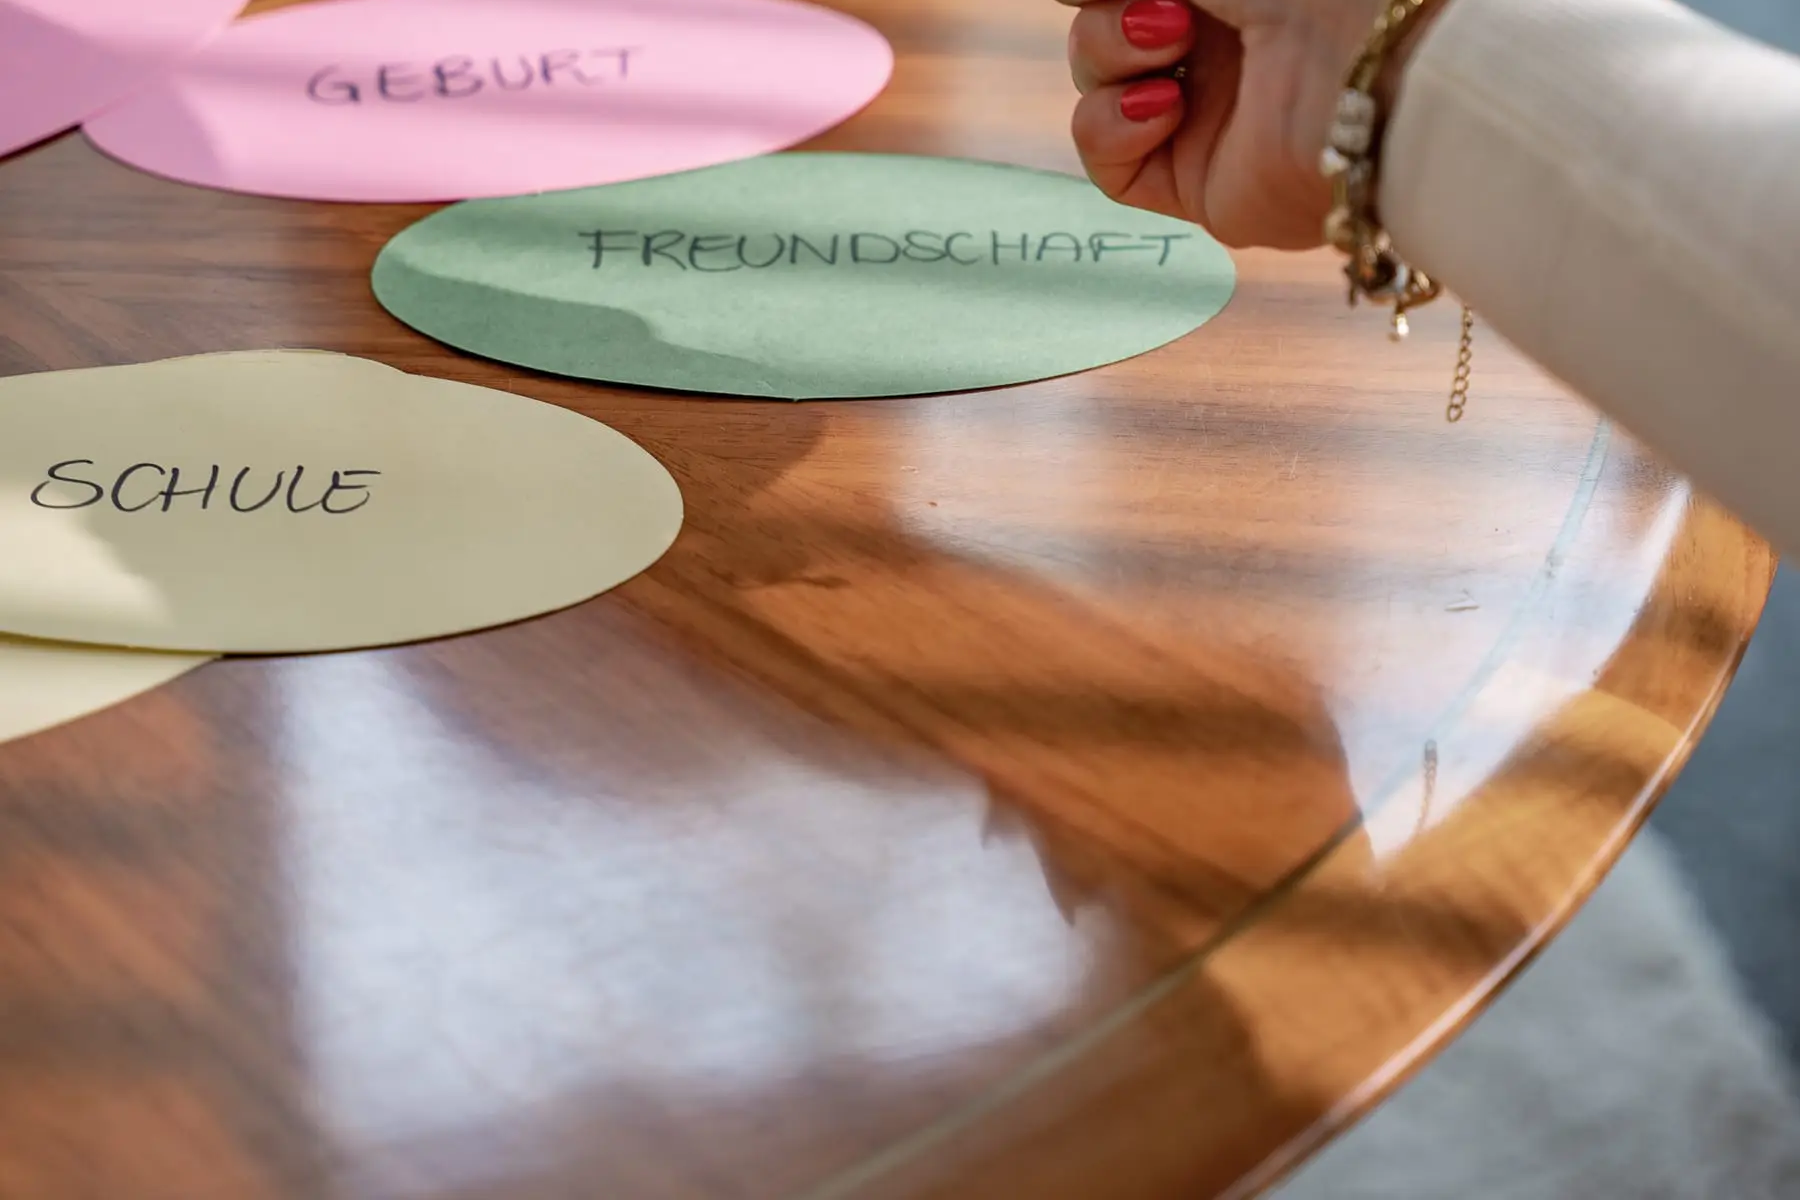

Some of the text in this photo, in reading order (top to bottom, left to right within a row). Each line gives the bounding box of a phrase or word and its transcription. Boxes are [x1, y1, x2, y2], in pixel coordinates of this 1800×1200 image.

[307, 46, 642, 106] GEBURT
[578, 228, 1193, 273] FREUNDSCHAFT
[30, 459, 381, 514] SCHULE
